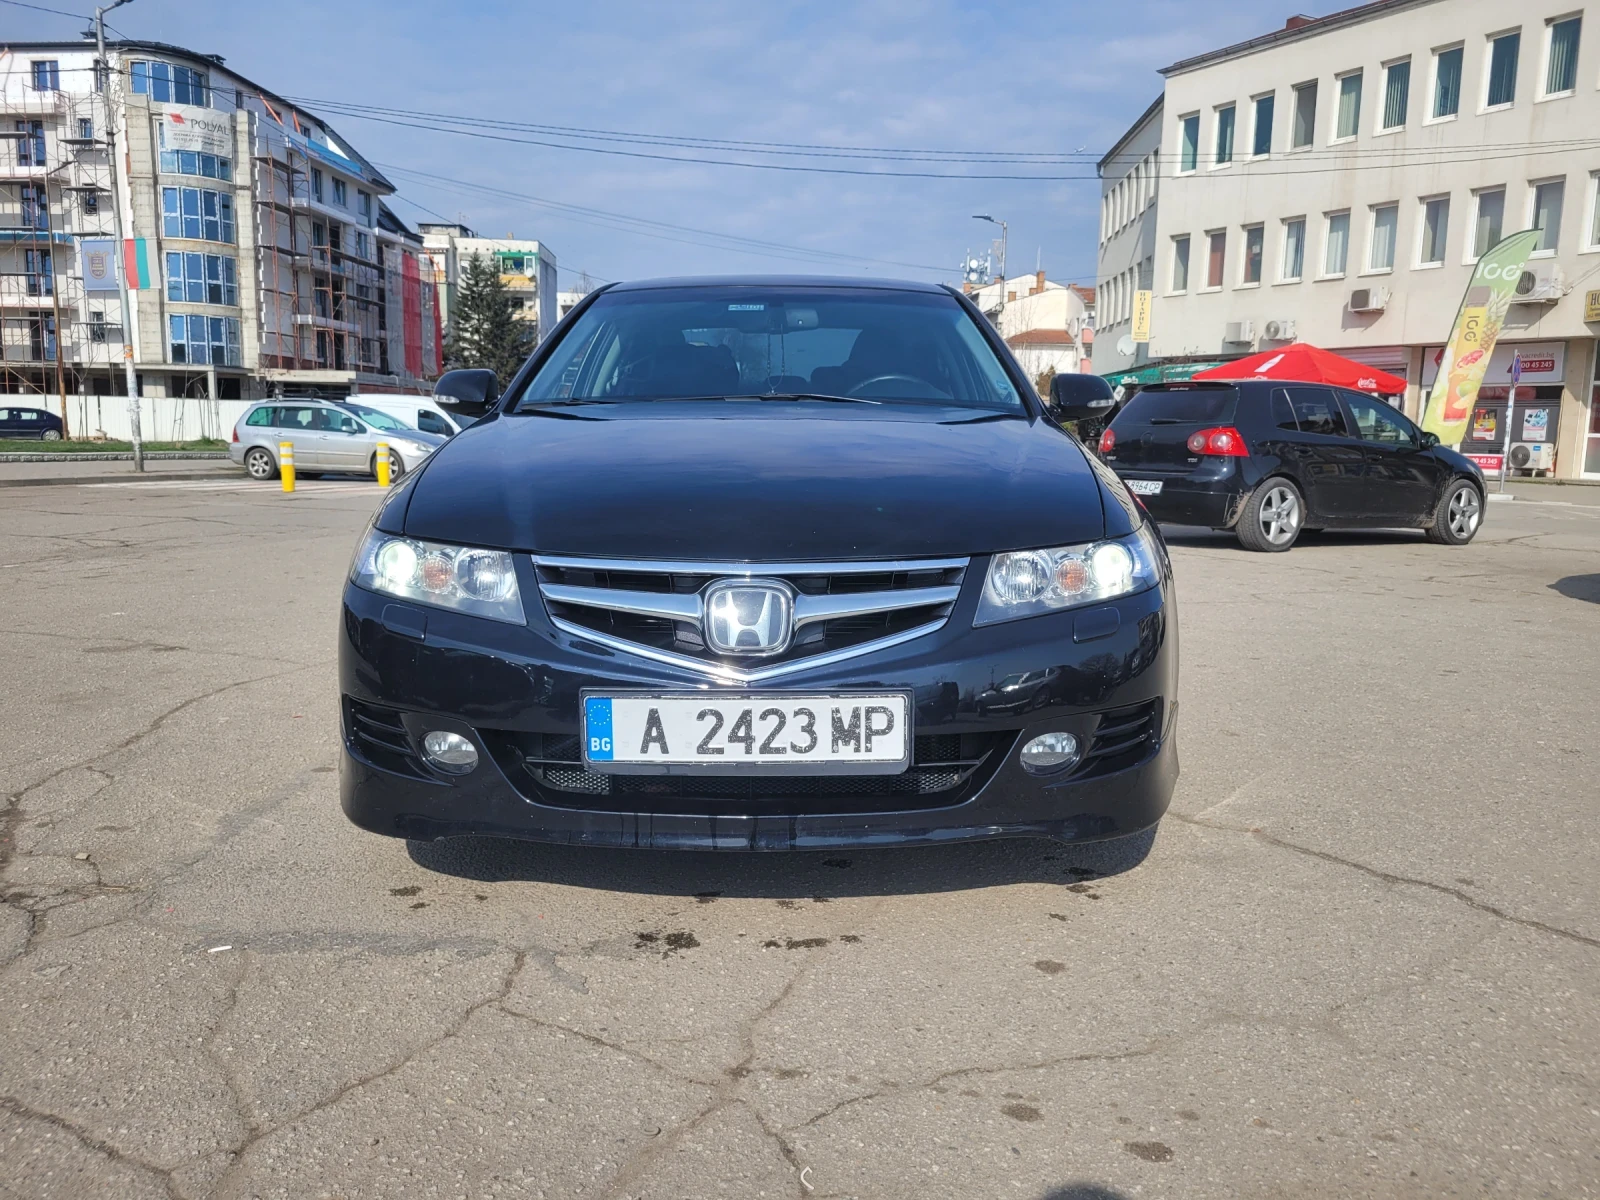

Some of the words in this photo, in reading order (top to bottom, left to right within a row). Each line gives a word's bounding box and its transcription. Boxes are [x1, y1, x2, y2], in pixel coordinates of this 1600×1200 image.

[191, 119, 229, 136] POLYAL
[639, 707, 670, 754] A
[696, 707, 818, 755] 2423
[831, 706, 895, 754] MP
[591, 737, 611, 752] BG
